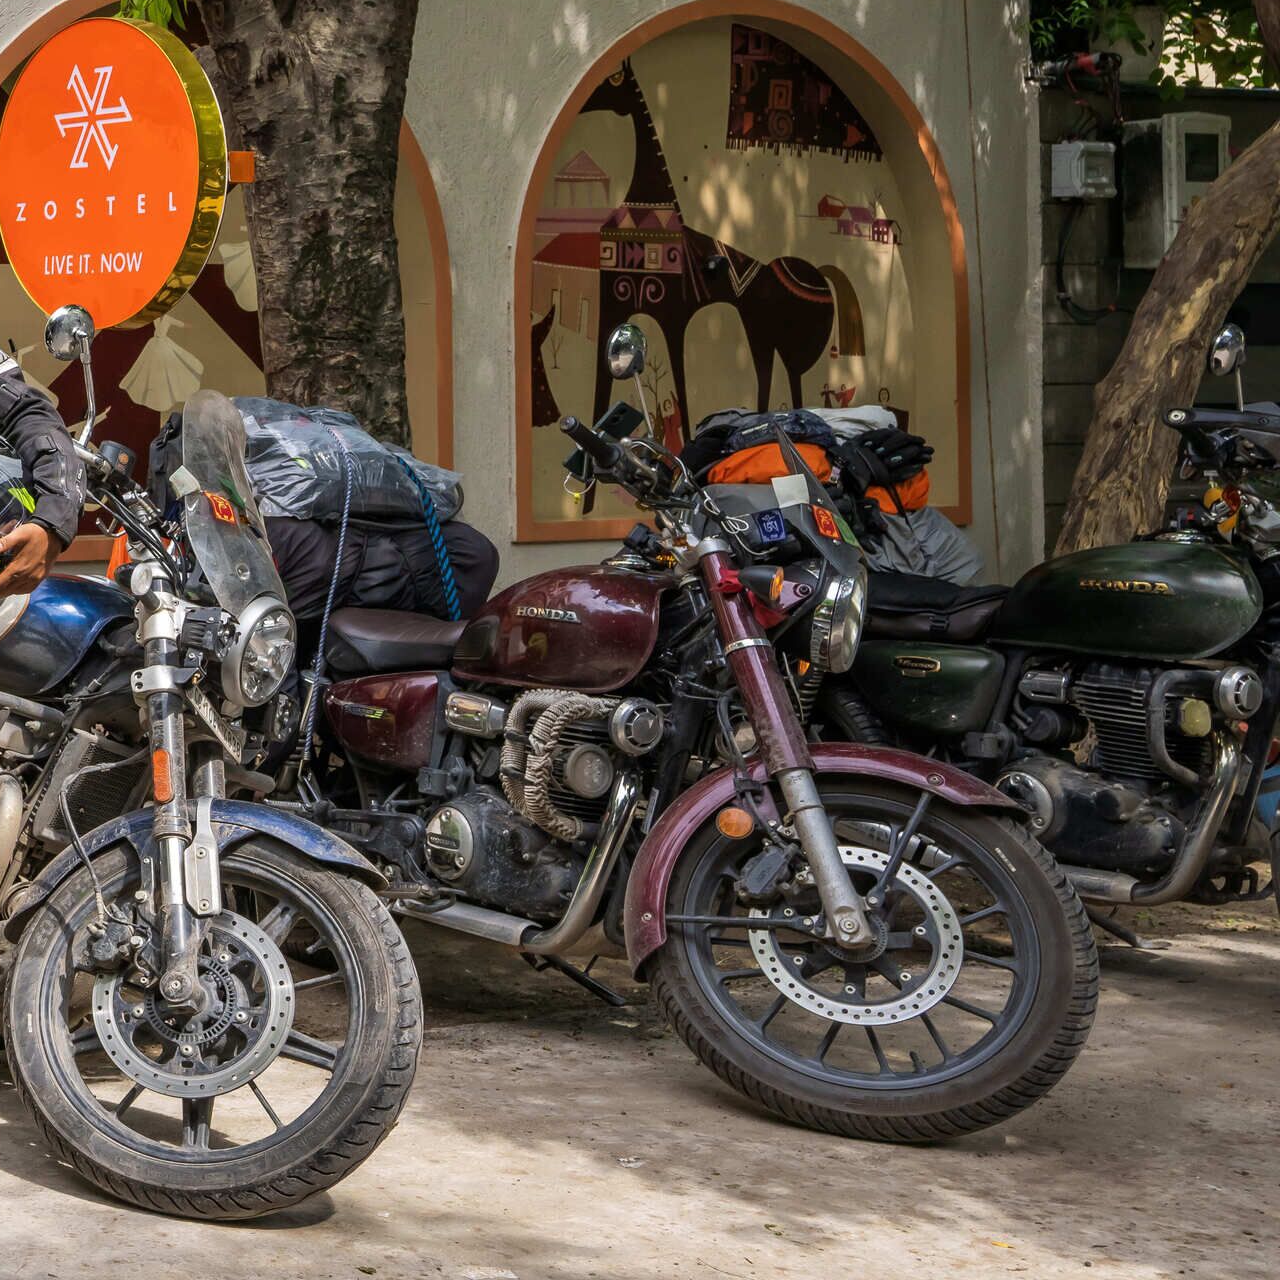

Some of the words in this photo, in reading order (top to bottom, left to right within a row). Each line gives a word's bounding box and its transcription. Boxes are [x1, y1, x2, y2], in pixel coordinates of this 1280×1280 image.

[15, 191, 177, 222] ZOSTEL
[44, 253, 74, 276] LIVE
[78, 252, 95, 275] IT.
[100, 251, 143, 274] NOW
[1079, 579, 1176, 596] HONDA
[516, 606, 581, 624] HONDA
